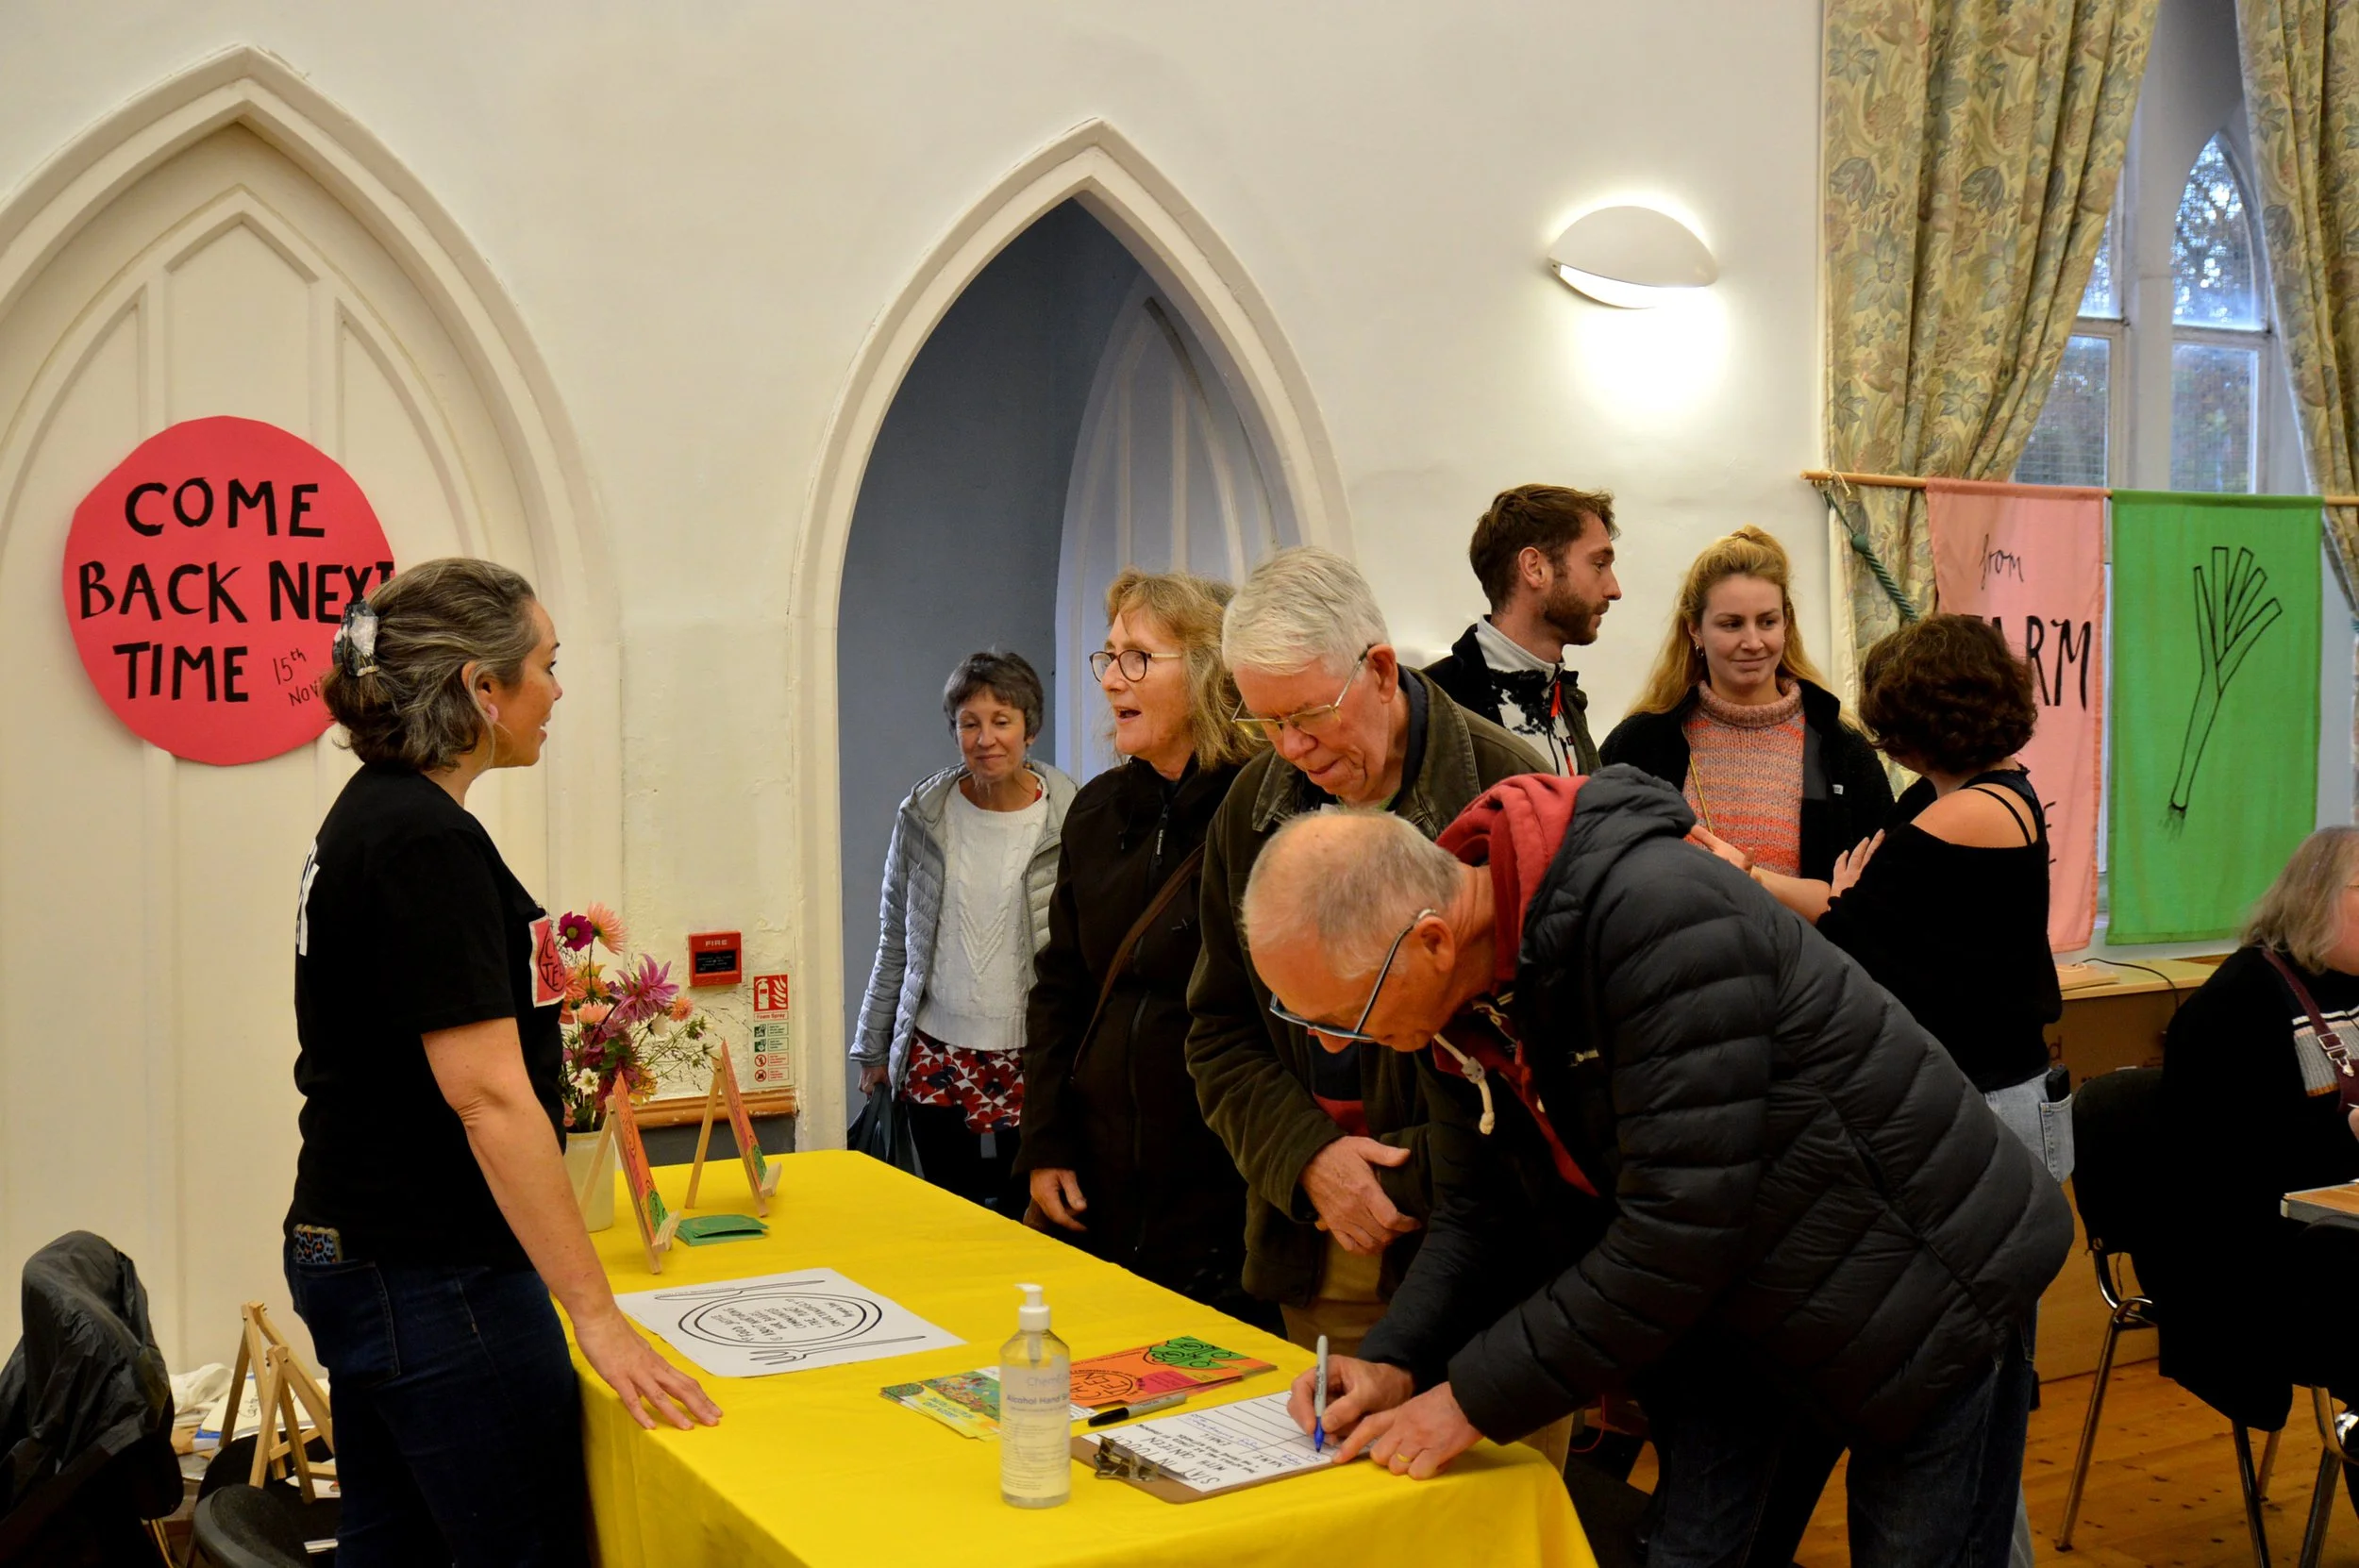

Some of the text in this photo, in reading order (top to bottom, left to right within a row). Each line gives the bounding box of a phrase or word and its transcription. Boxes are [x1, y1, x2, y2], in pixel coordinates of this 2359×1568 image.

[124, 476, 326, 538] COME
[1979, 533, 2024, 591] from
[78, 559, 247, 624] BACK
[112, 641, 249, 703] TIME
[273, 648, 307, 686] 15th
[705, 939, 728, 947] FIRE
[1007, 1394, 1036, 1405] Alcohol
[1039, 1395, 1061, 1404] Hand
[1146, 1437, 1228, 1471] WITH CANTEEN
[1199, 1432, 1231, 1446] EMAIL
[1180, 1467, 1220, 1485] STAY
[1251, 1454, 1286, 1468] NAME
